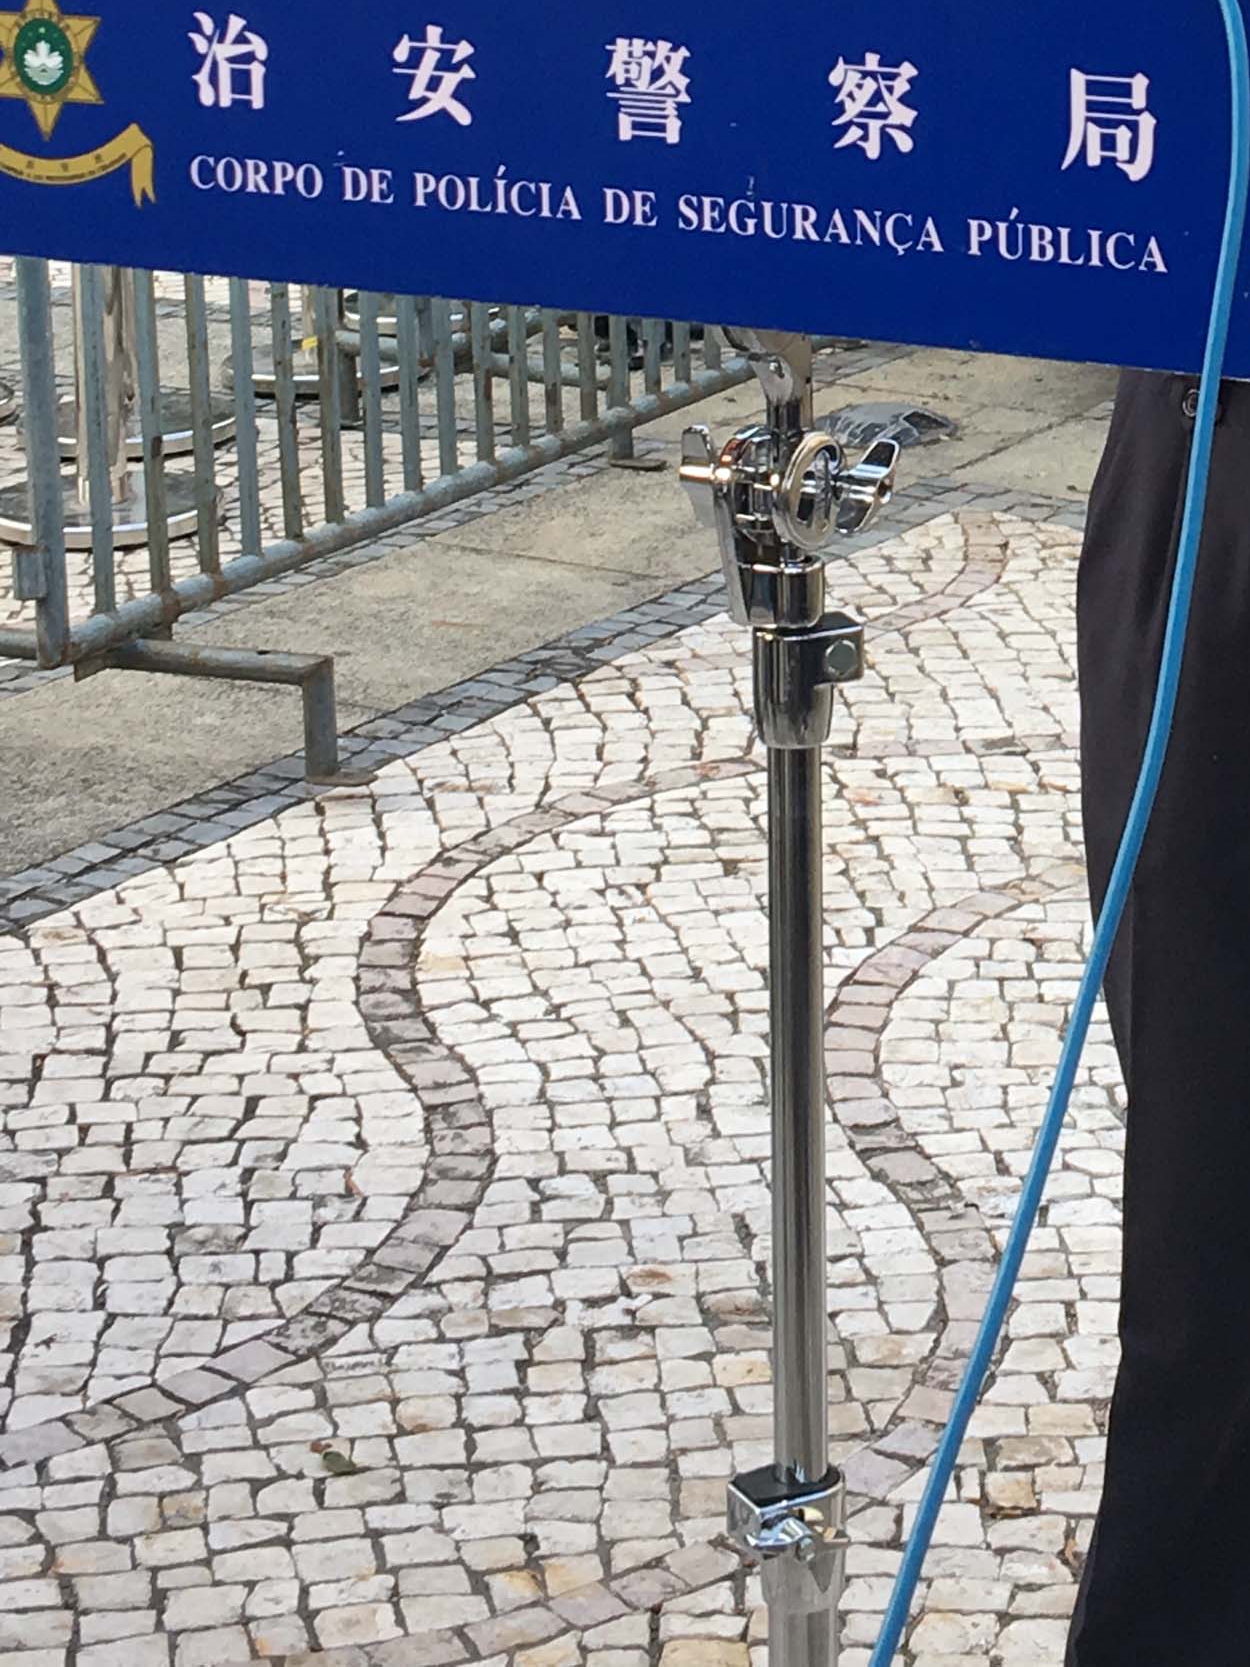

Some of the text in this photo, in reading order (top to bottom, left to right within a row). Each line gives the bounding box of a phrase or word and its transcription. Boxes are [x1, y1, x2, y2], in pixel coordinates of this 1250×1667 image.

[188, 12, 1157, 181] 治安警察局
[190, 155, 1168, 273] CORPO DE POLÍCIA DE SEGURANÇA PÚBLICA
